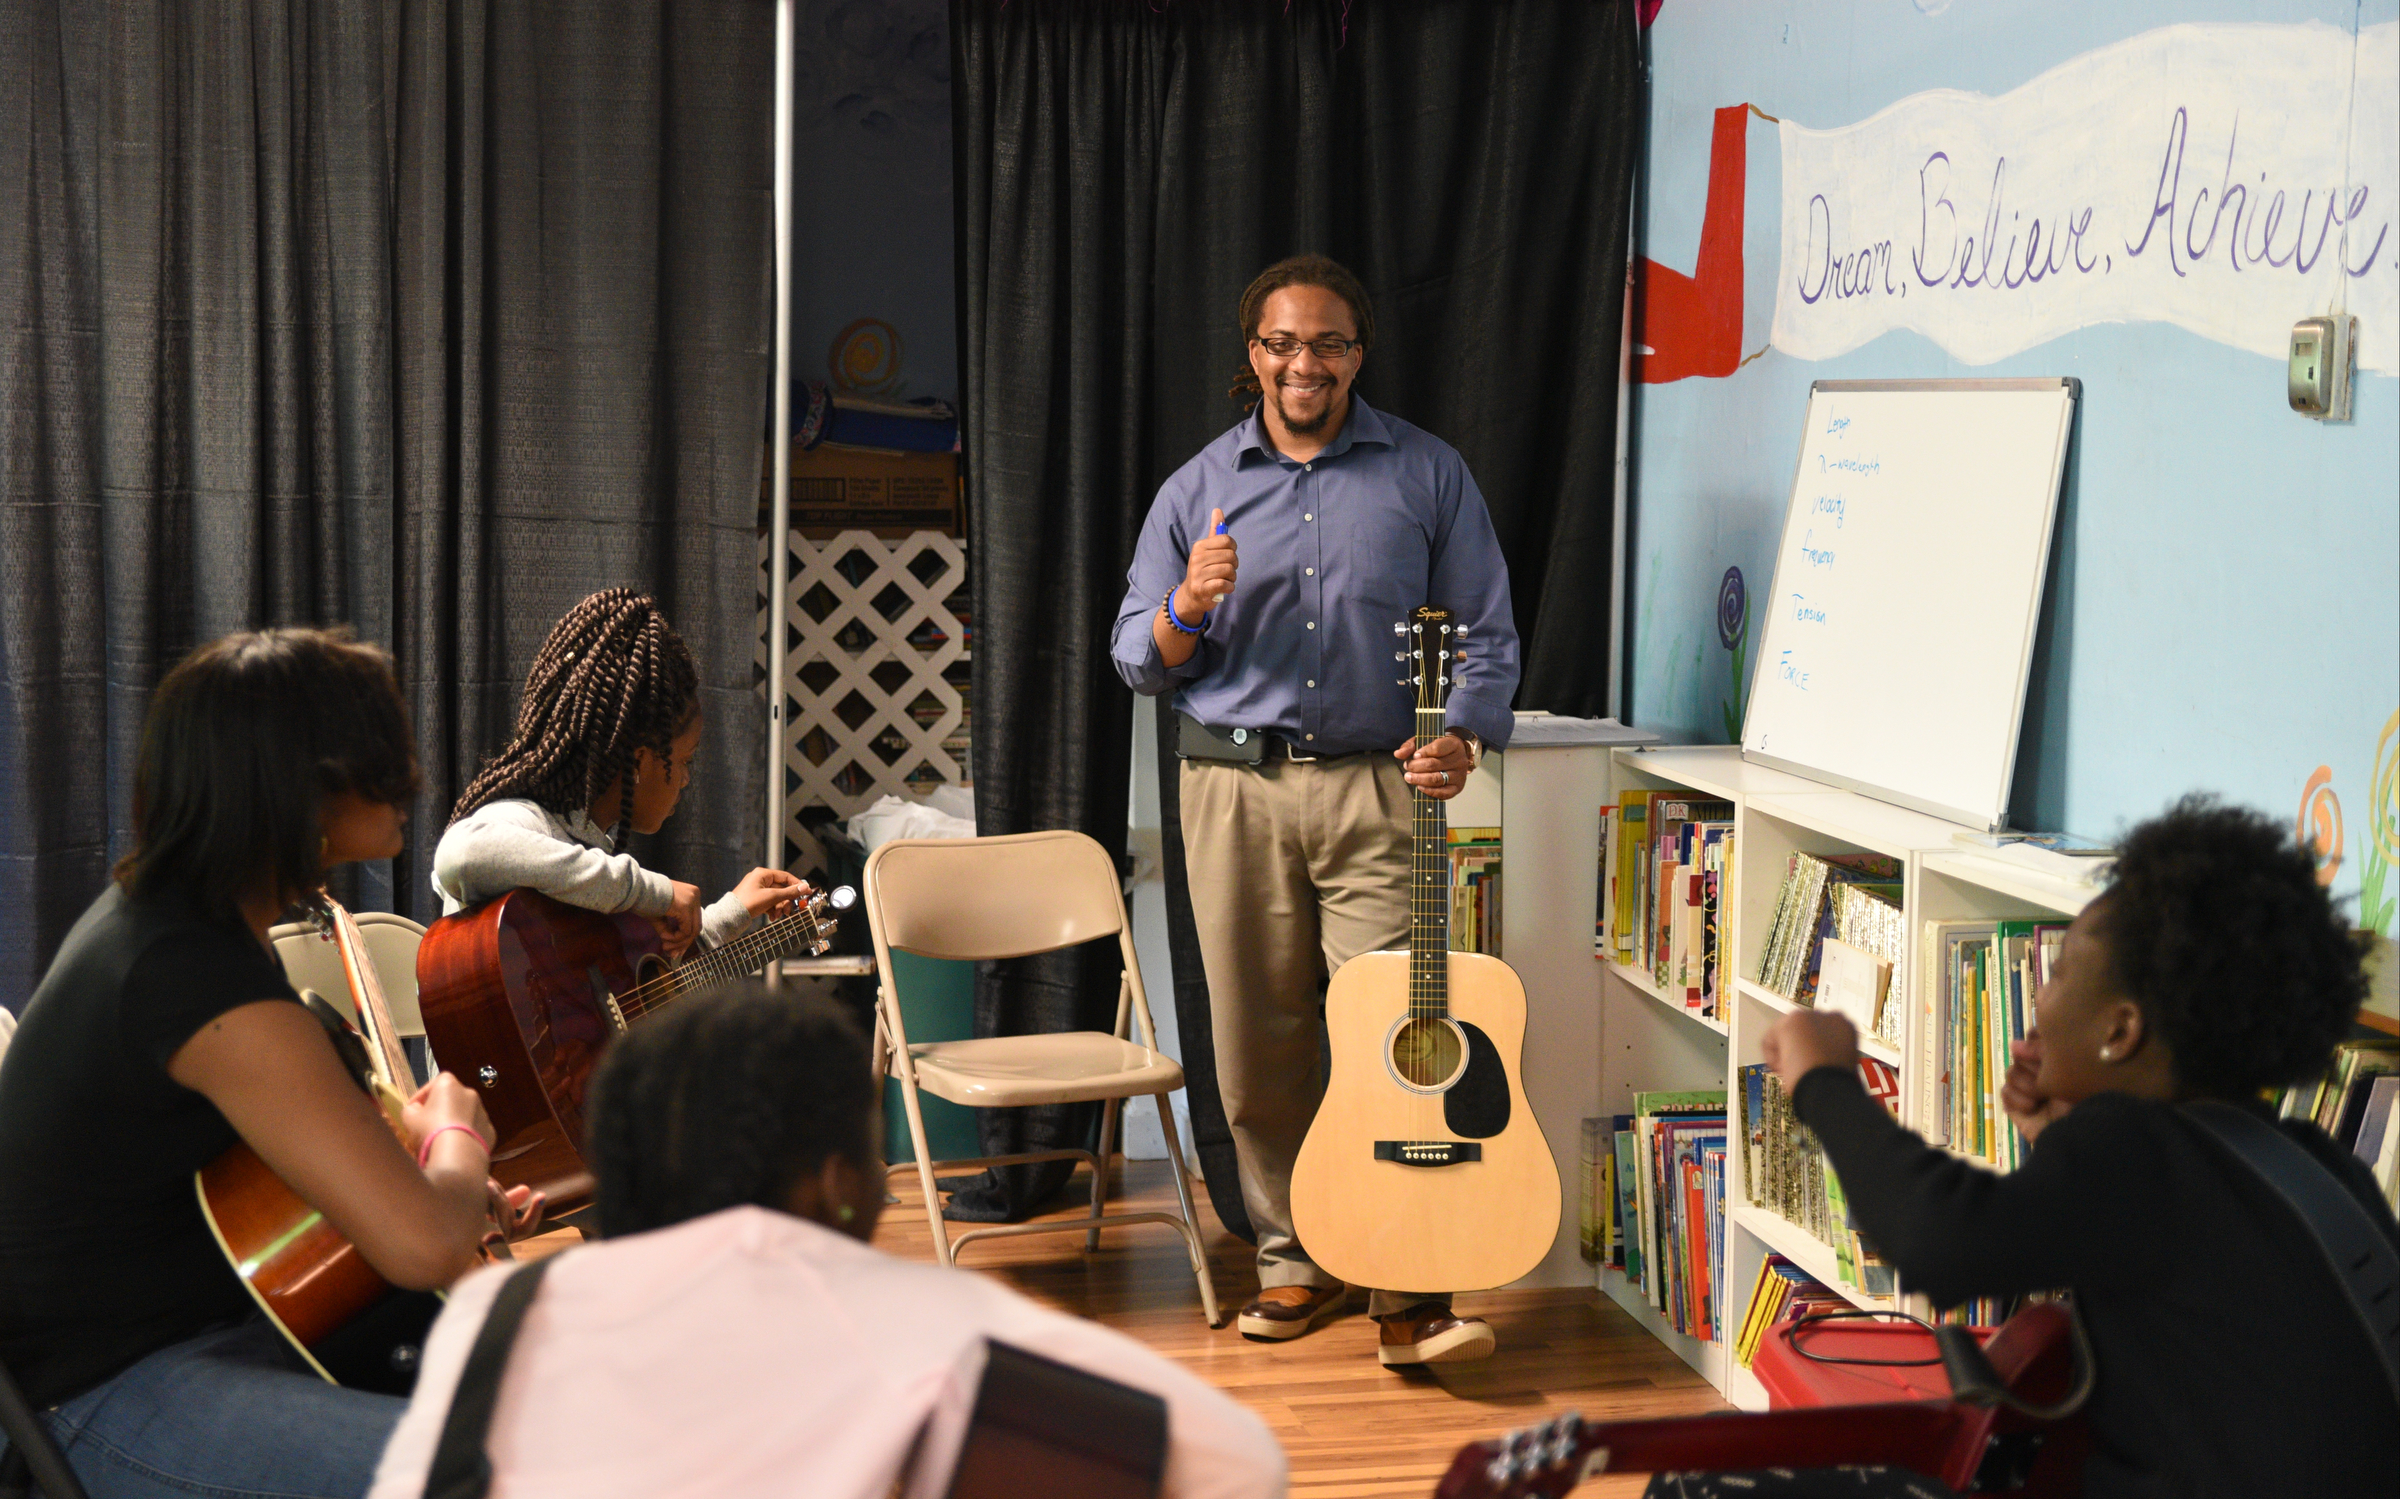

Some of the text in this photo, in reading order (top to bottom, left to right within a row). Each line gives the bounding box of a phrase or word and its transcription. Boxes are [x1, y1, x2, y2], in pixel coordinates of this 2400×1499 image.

[1798, 193, 1907, 305] Dream,
[1912, 151, 2113, 290] Believe,
[1416, 606, 1448, 621] Squier
[1668, 804, 1687, 817] DK
